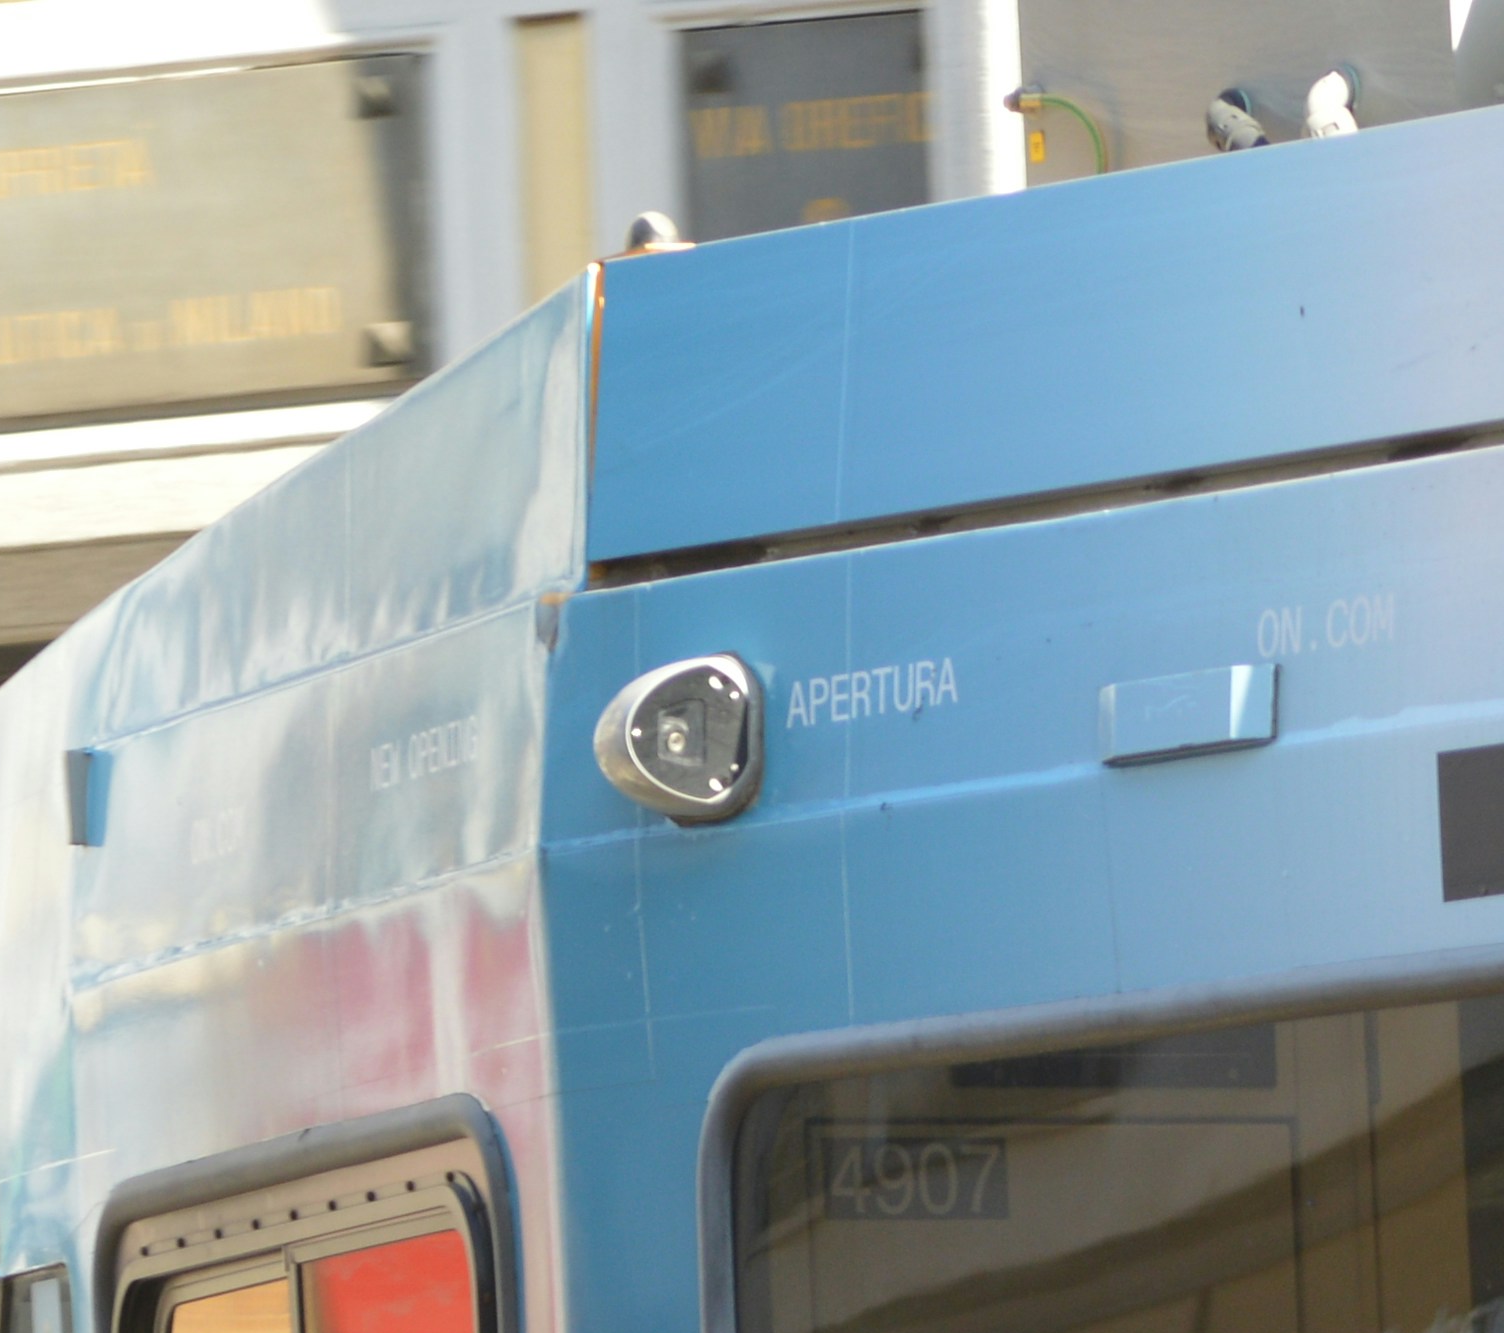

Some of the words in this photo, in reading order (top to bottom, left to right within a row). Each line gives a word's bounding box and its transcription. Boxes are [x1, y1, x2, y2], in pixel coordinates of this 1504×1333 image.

[1256, 594, 1397, 664] ON.COM
[786, 656, 959, 730] APERTURA
[831, 1142, 1003, 1217] 4907
